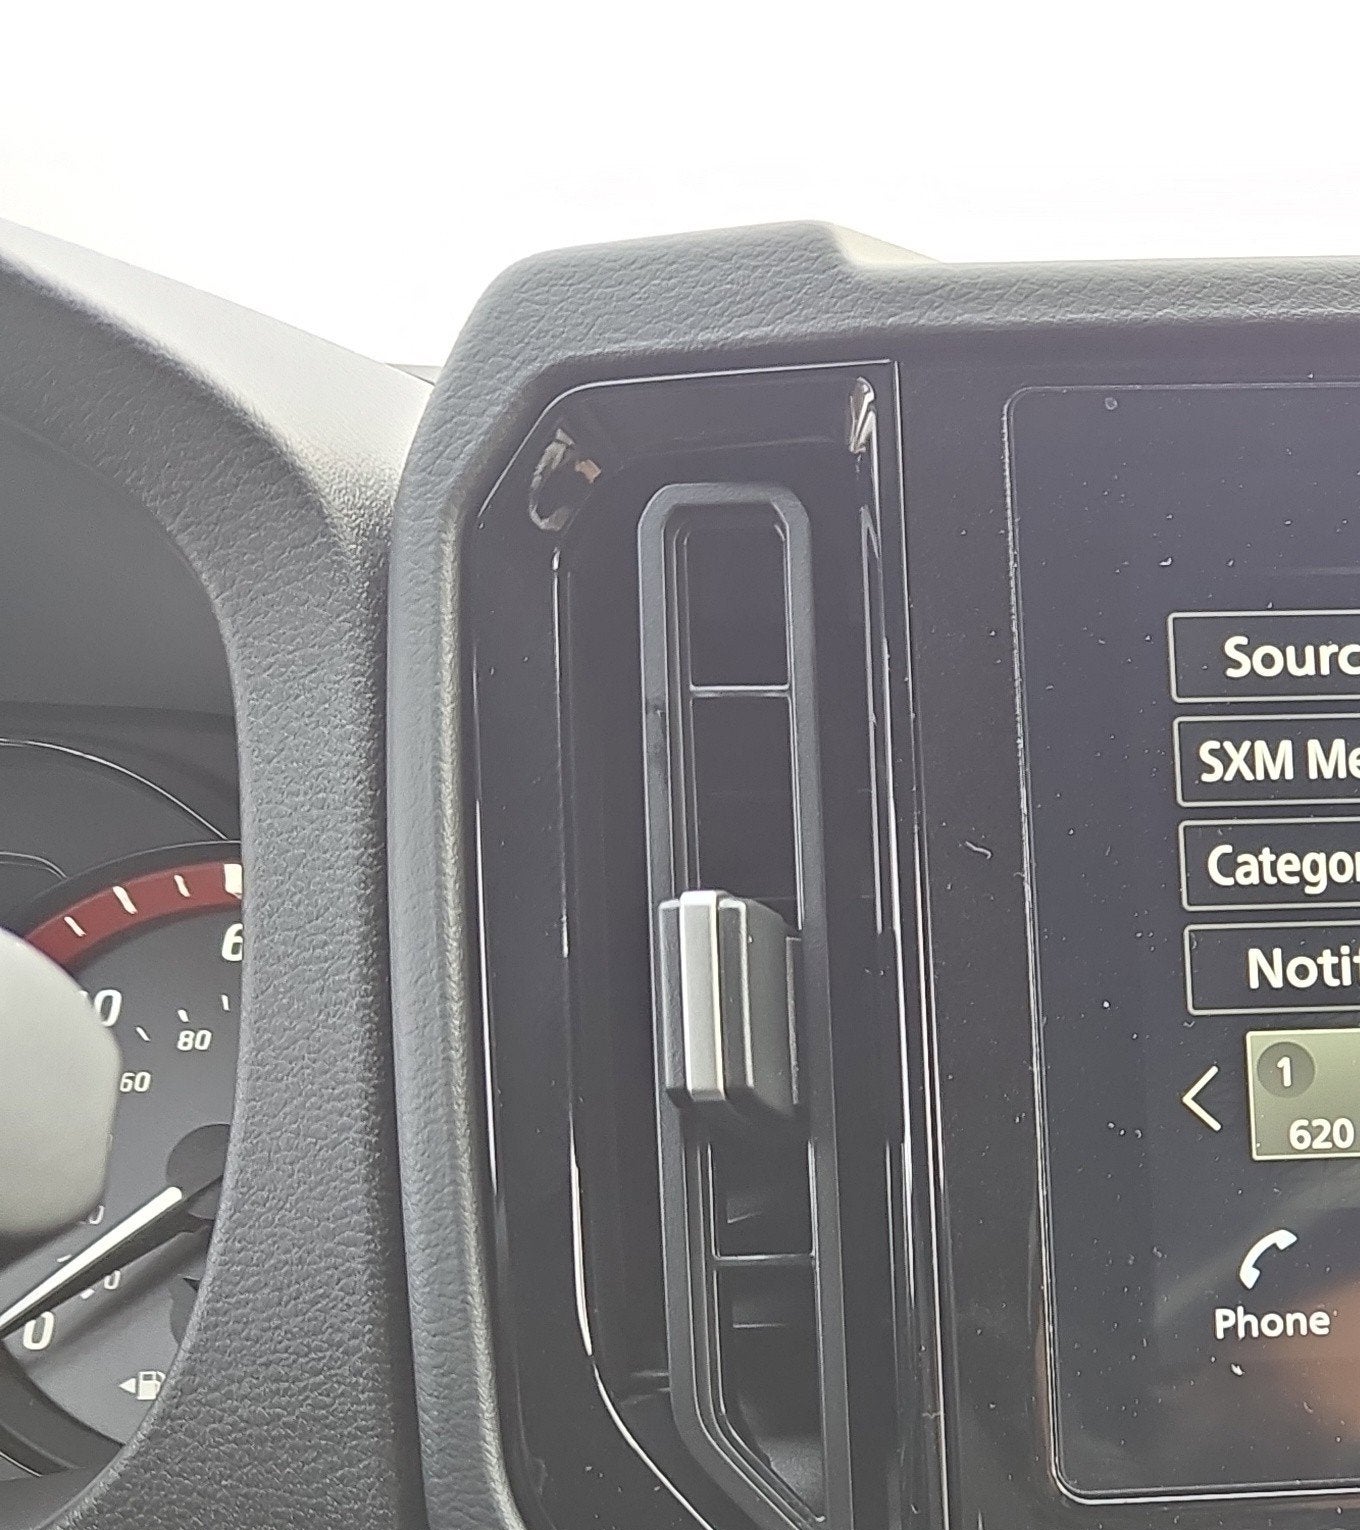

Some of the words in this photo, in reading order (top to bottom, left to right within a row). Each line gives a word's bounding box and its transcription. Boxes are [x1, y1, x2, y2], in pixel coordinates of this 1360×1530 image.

[1199, 739, 1294, 782] SXM
[177, 1029, 212, 1051] 80
[119, 1071, 151, 1093] 60
[1276, 1056, 1293, 1087] 1
[1289, 1118, 1354, 1150] 620
[1215, 1306, 1330, 1340] Phone
